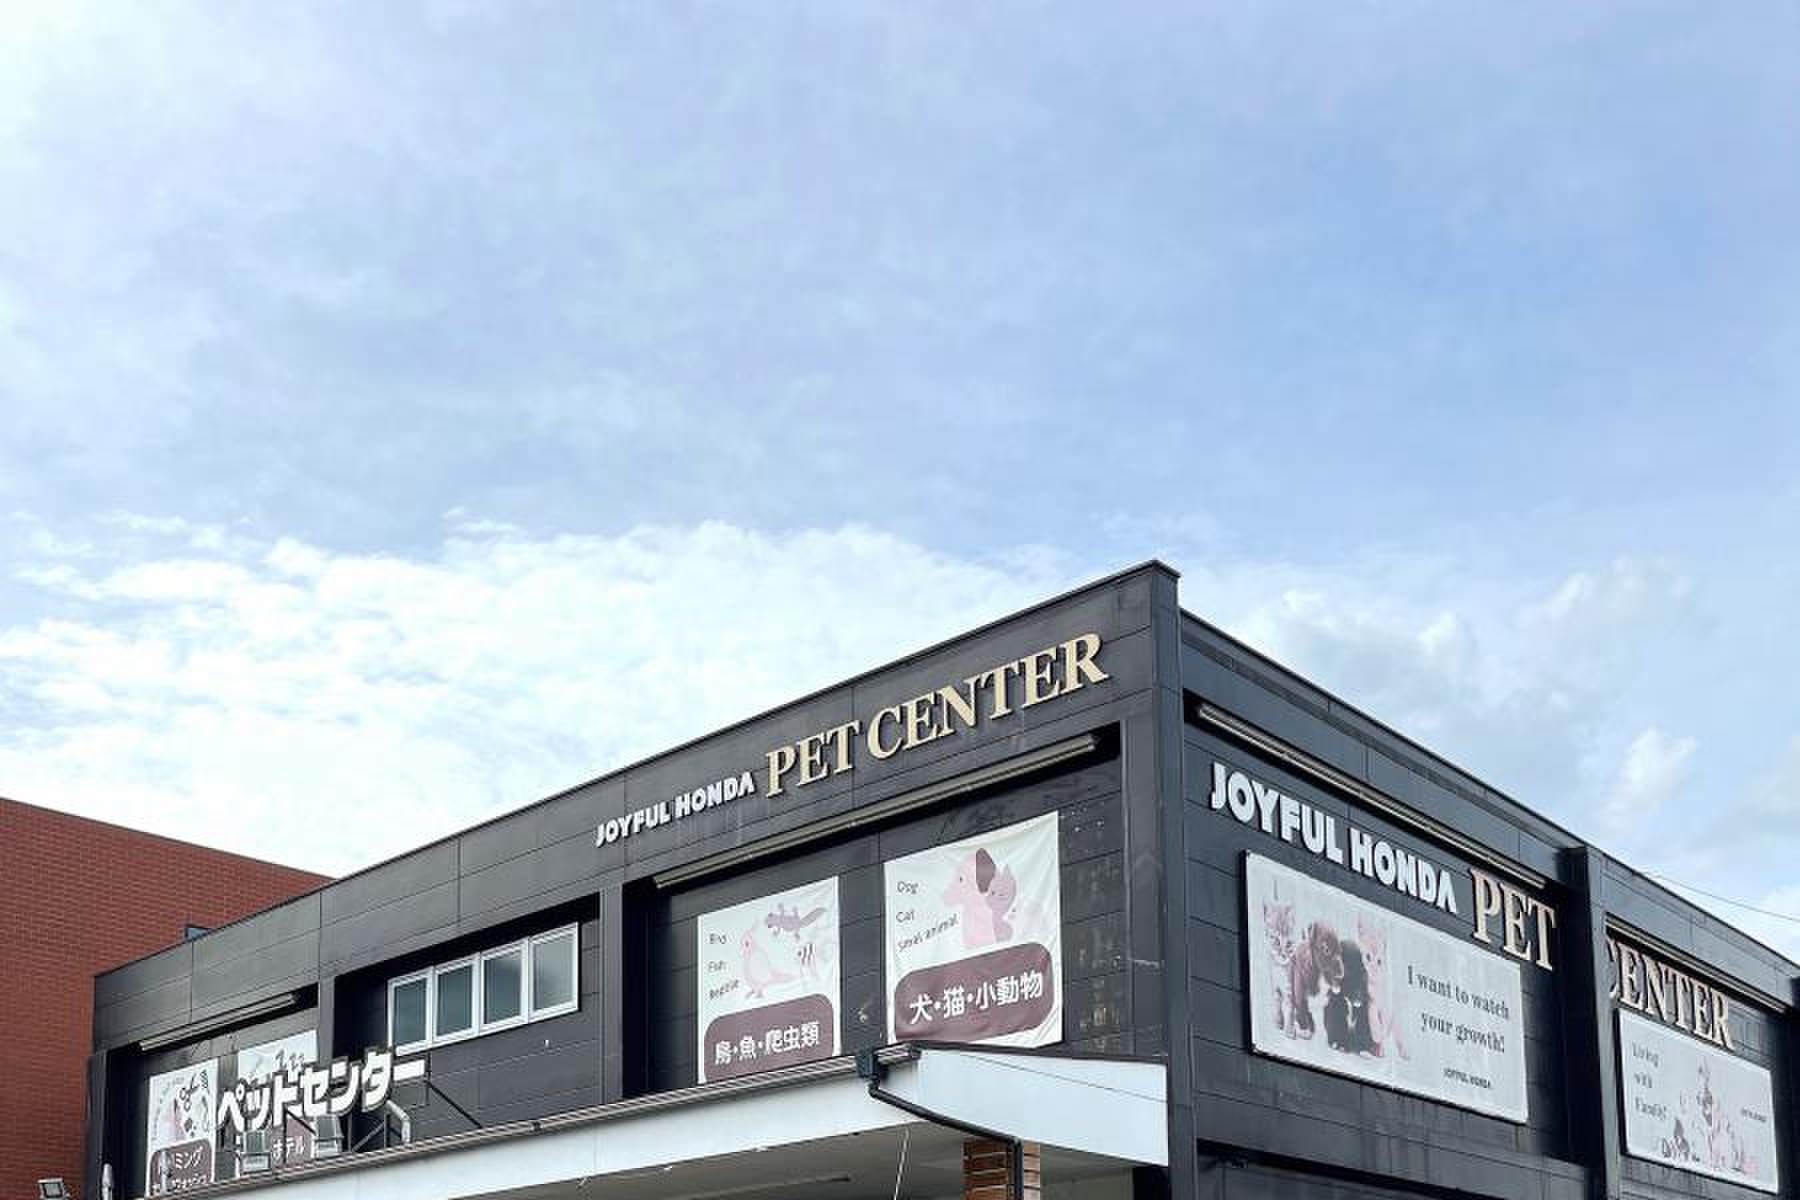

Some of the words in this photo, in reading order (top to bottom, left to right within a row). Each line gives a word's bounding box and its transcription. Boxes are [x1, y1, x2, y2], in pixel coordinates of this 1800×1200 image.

[596, 800, 672, 847] JOYFUL
[675, 771, 756, 819] HONDA
[766, 718, 862, 798] PET
[867, 632, 1110, 760] CENTER
[897, 880, 919, 895] Dog
[1210, 761, 1344, 866] JOYFUL
[1350, 826, 1458, 914] HONDA
[1470, 867, 1555, 971] PET
[1605, 934, 1735, 1051] ENTER
[895, 911, 915, 924] Cat
[1407, 964, 1413, 985] I
[1416, 973, 1452, 999] want
[1455, 985, 1469, 1004] to
[1471, 993, 1509, 1019] watch
[1421, 1011, 1453, 1035] your
[217, 1048, 426, 1134] ペットセンター
